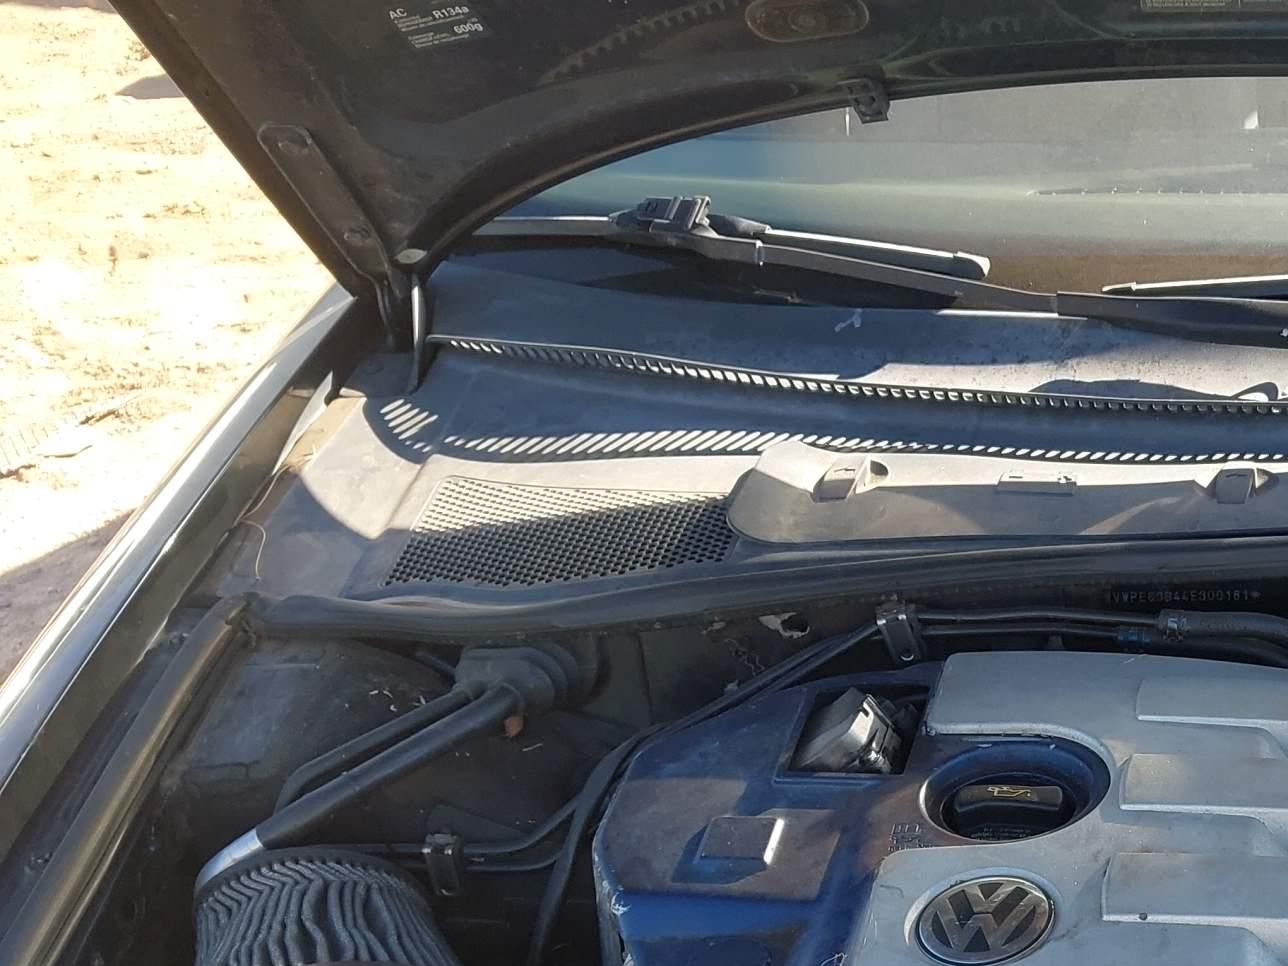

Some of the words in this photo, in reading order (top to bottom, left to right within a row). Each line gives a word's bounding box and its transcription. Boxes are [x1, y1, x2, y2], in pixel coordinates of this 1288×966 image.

[389, 8, 407, 19] AC
[432, 6, 469, 19] R134a
[453, 23, 484, 34] 600g
